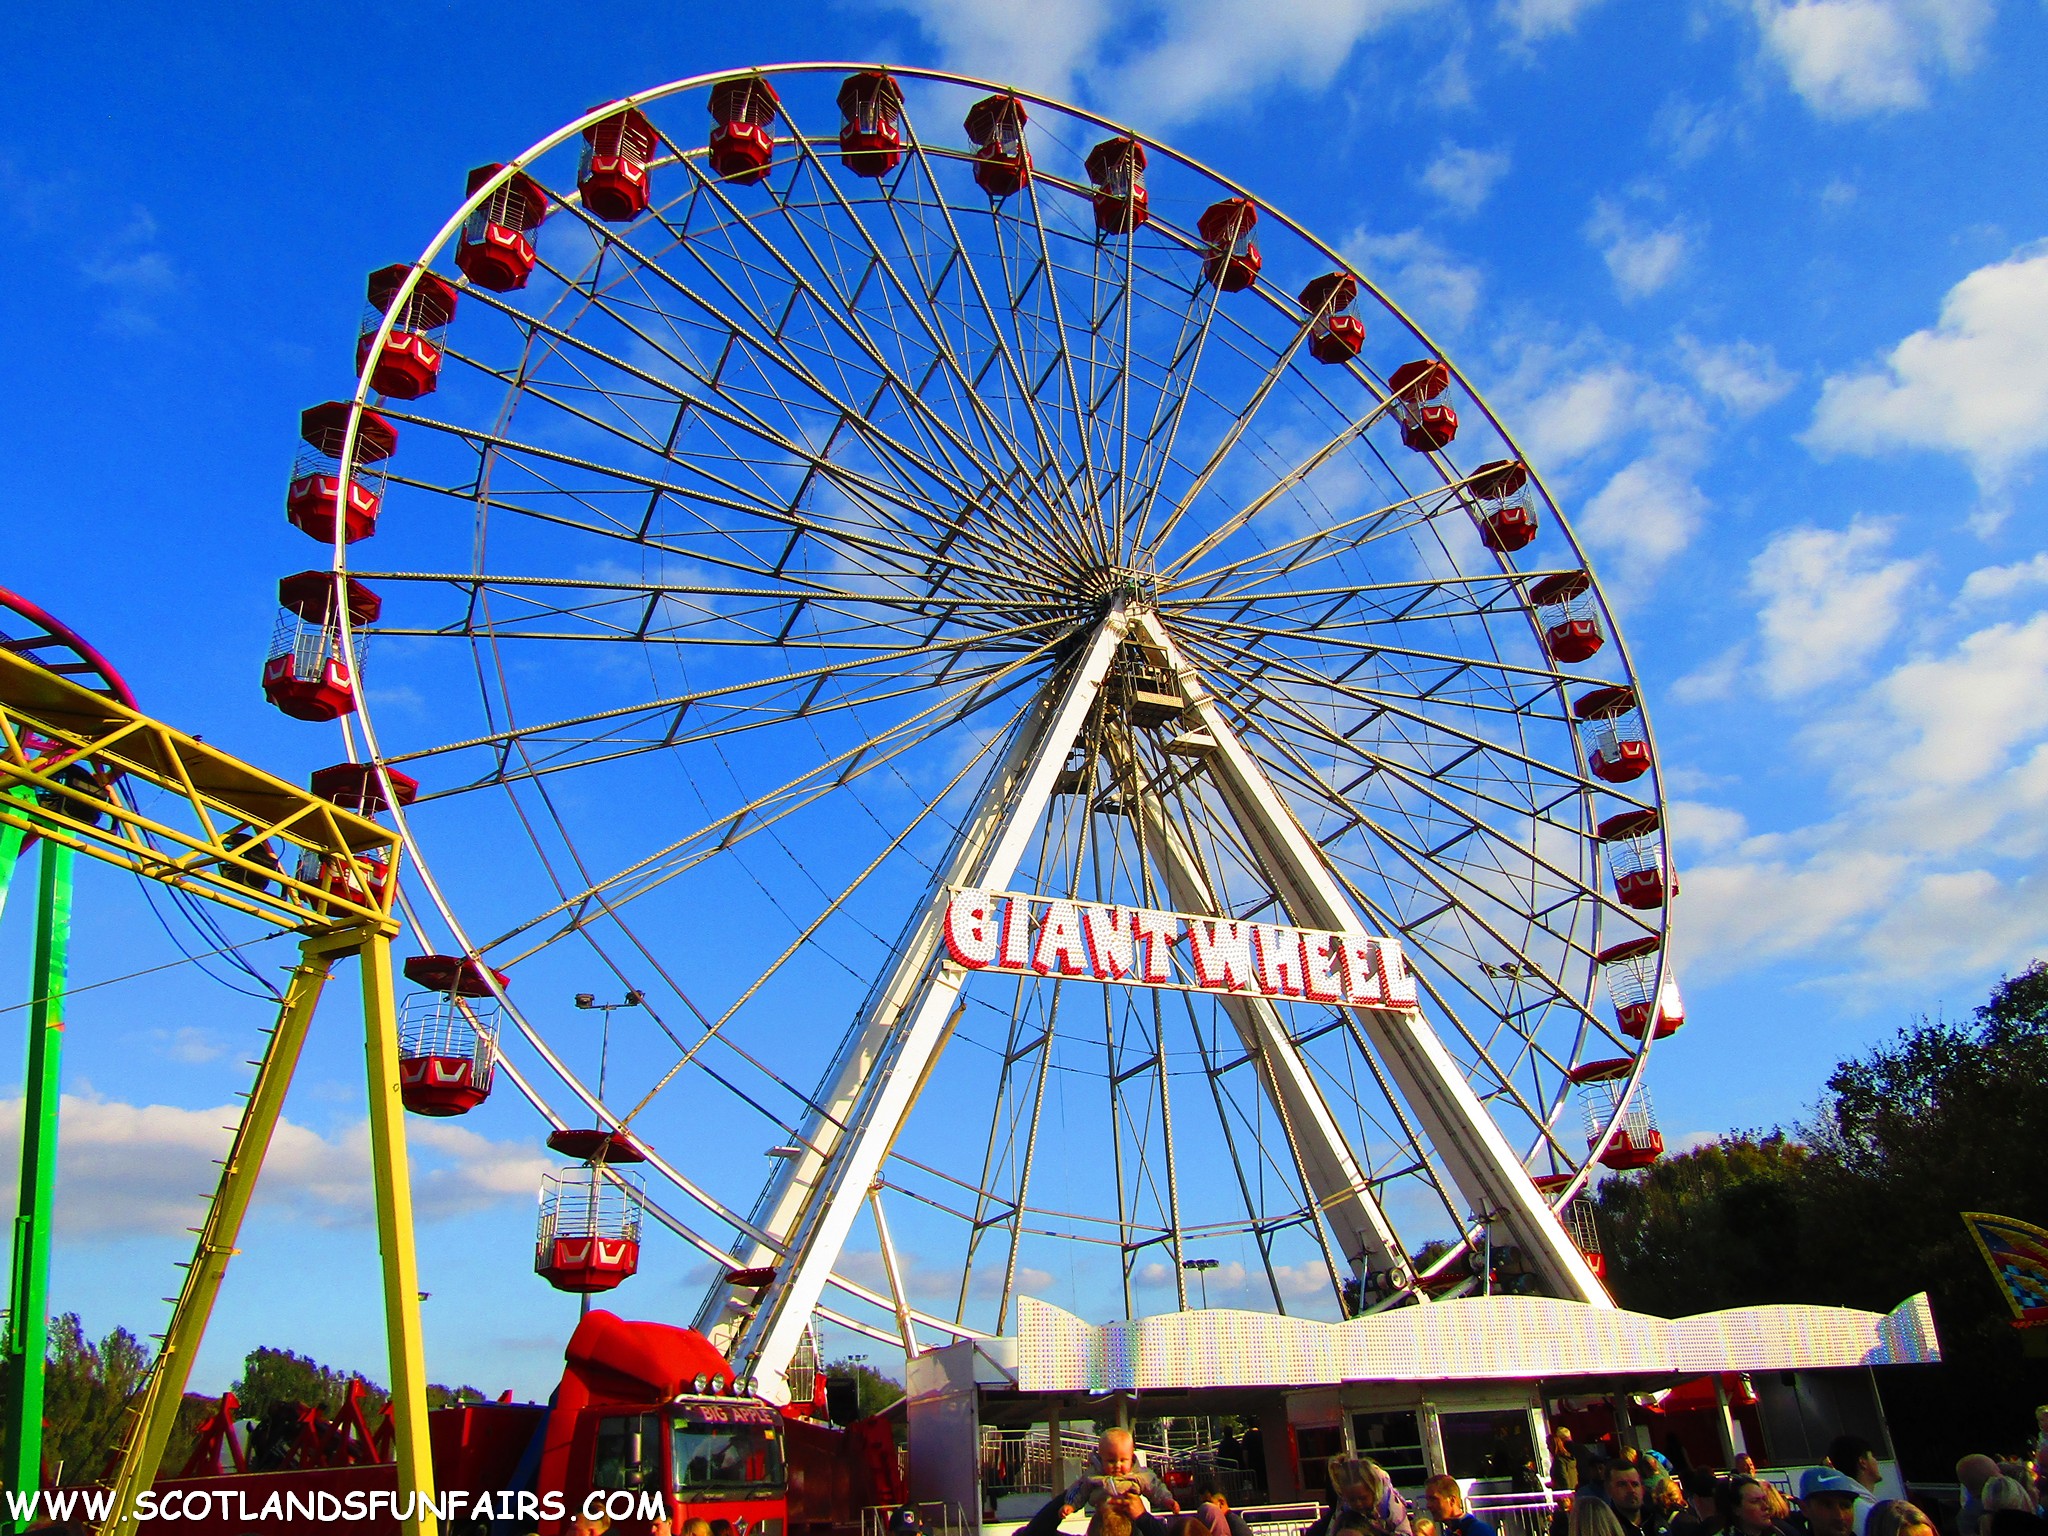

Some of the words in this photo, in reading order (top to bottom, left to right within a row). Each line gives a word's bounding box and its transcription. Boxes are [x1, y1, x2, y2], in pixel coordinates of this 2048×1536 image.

[945, 887, 1178, 983] GIANT
[1189, 919, 1417, 1008] WHEEL
[700, 1406, 729, 1422] BIG
[733, 1407, 774, 1423] APPLE
